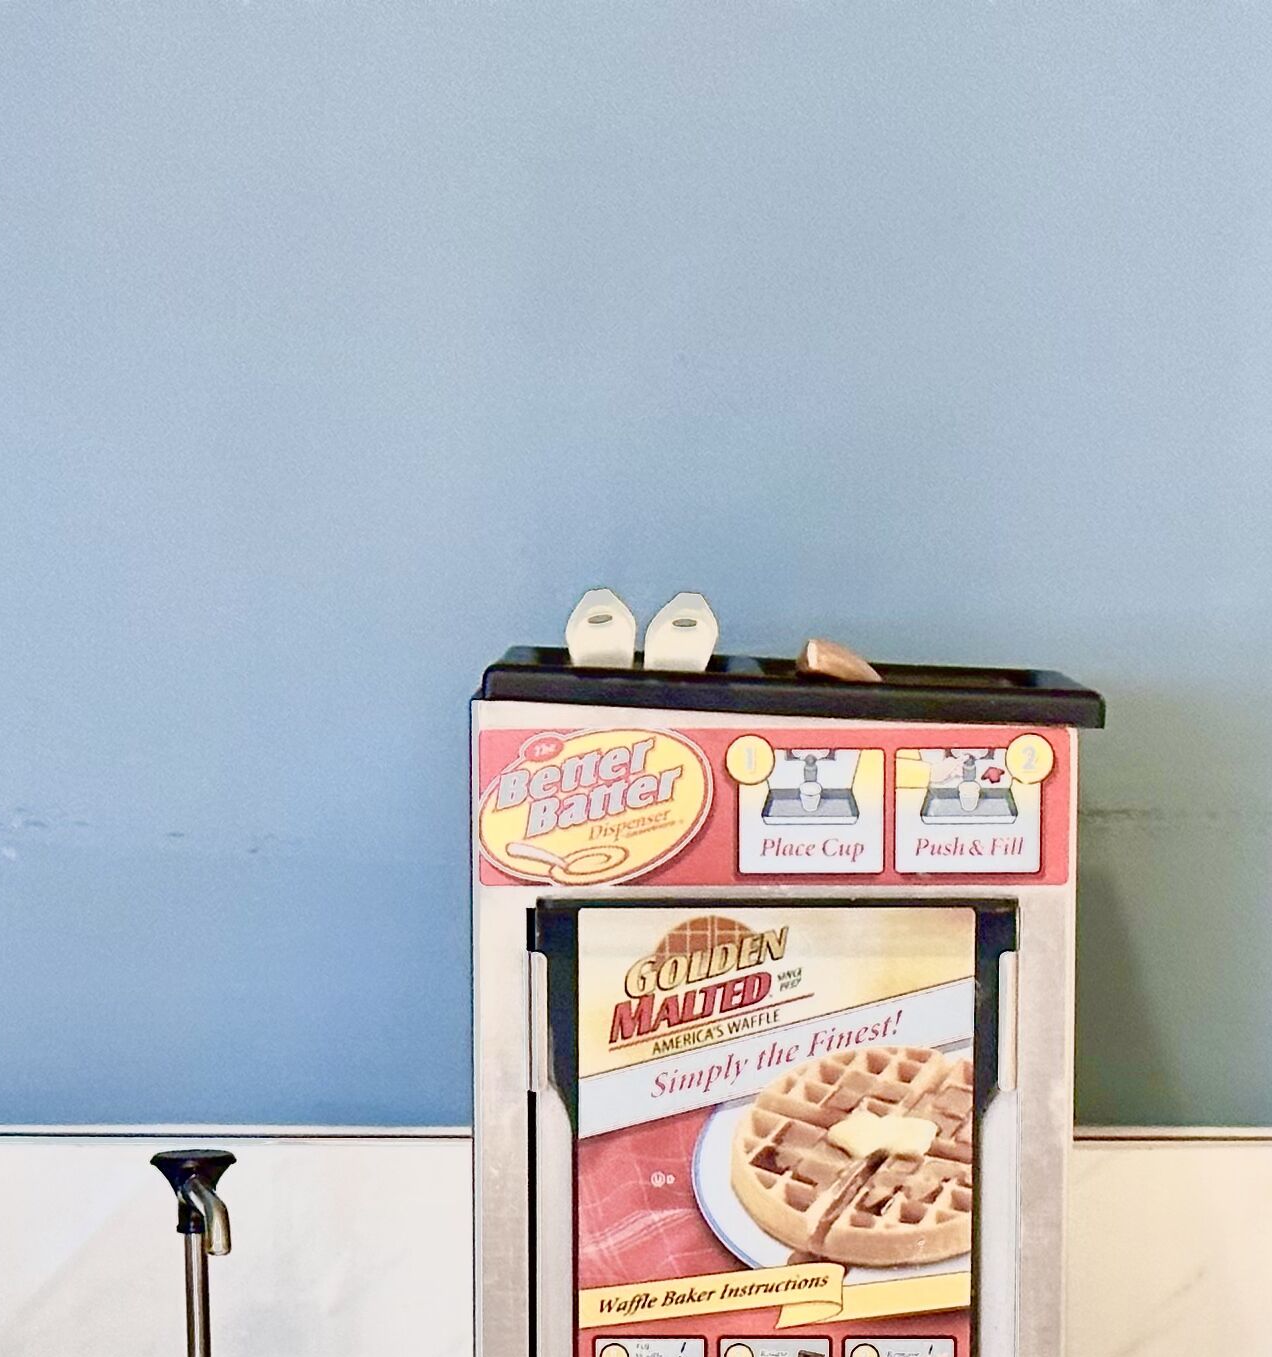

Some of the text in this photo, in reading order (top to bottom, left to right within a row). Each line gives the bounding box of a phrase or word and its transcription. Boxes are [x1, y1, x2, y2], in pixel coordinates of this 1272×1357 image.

[495, 737, 656, 810] Better
[742, 748, 755, 770] 1
[1021, 747, 1037, 771] 2
[526, 766, 683, 838] Batter
[589, 809, 671, 841] Dispenser
[915, 837, 1024, 857] Push & Fill
[759, 837, 864, 862] Place Cup
[625, 926, 789, 998] GOLDEN
[609, 972, 773, 1044] MALTED
[651, 1009, 903, 1099] Simply the Finest!
[652, 1009, 780, 1055] AMERICA'S WAFFLE
[599, 1274, 830, 1316] Waffle Baker Instructions
